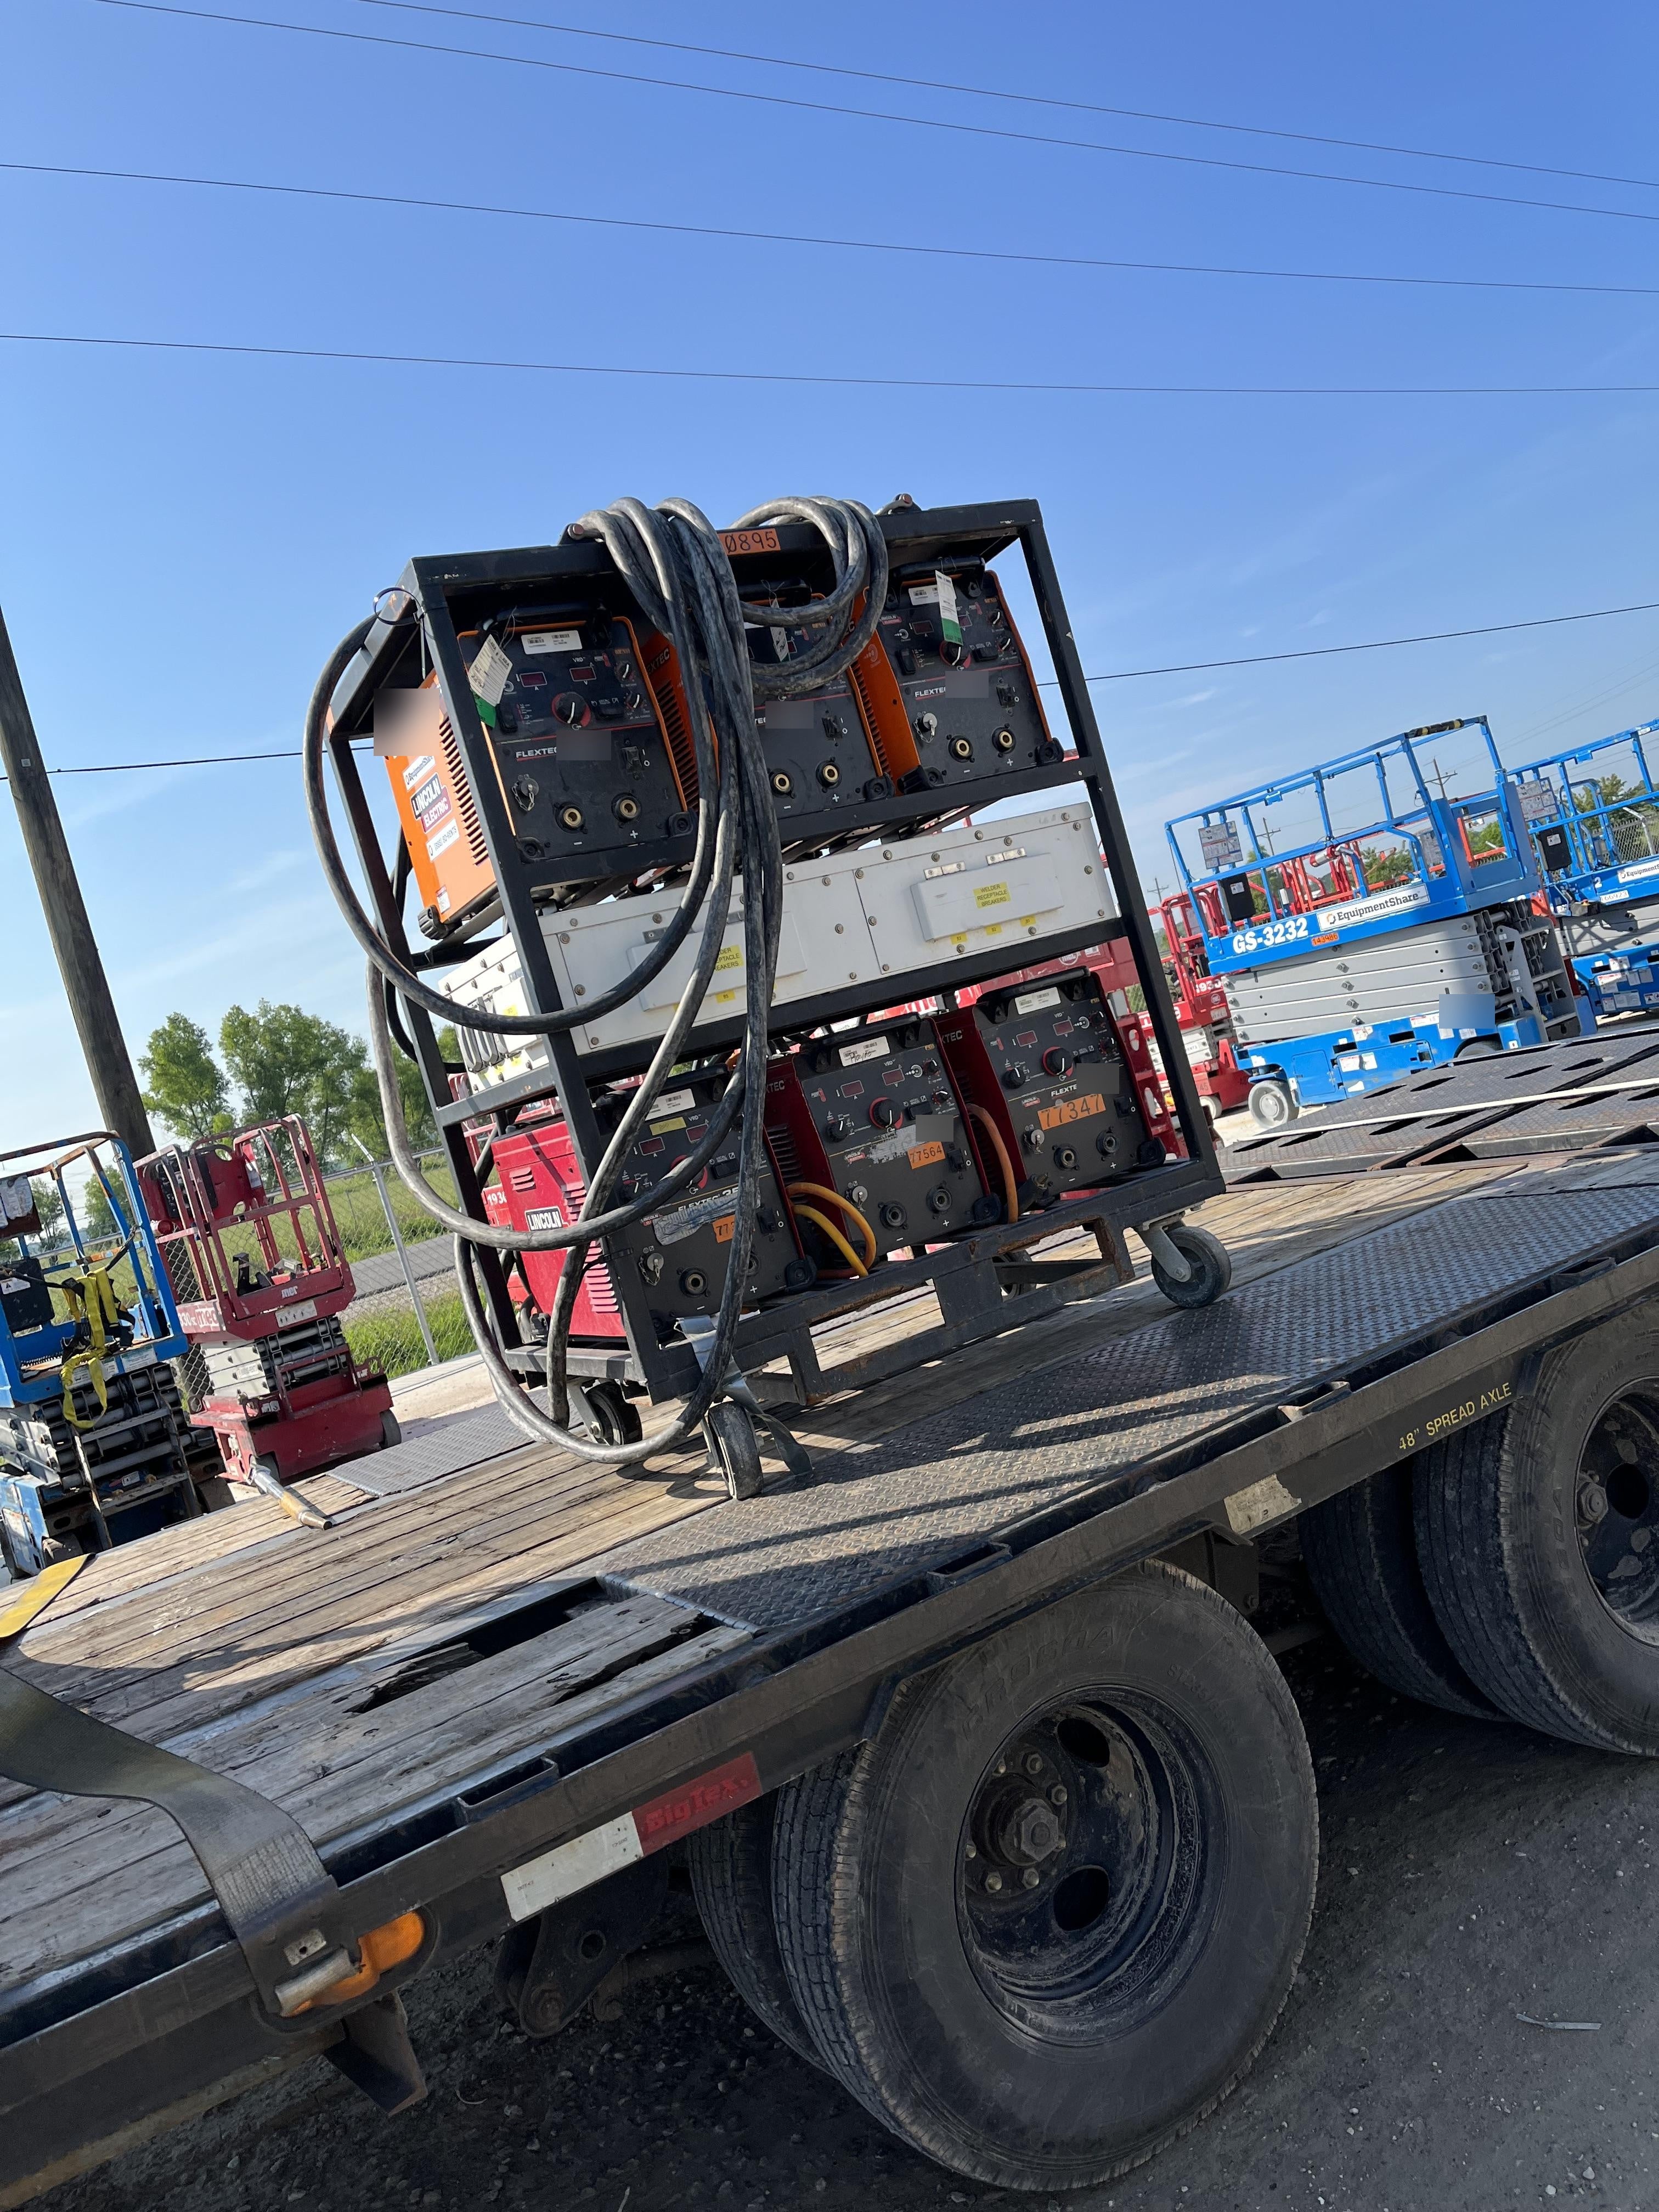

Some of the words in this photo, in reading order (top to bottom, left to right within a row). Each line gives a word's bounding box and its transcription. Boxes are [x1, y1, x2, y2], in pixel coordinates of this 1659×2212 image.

[412, 778, 441, 816] LINCOLN
[423, 797, 449, 828] ELECTRIC
[977, 889, 1008, 901] RECEPTACLE
[980, 884, 1001, 893] WELDER
[981, 896, 1007, 907] BREAKERS
[1336, 891, 1419, 922] EquipmentShare
[1233, 917, 1308, 954] GS-3232
[1041, 1094, 1100, 1127] 77347
[910, 1146, 943, 1164] 77564
[527, 1211, 562, 1231] LINCOLN
[1399, 1428, 1419, 1449] 48"
[1426, 1401, 1475, 1436] SPREAD
[1481, 1382, 1512, 1409] AXLE
